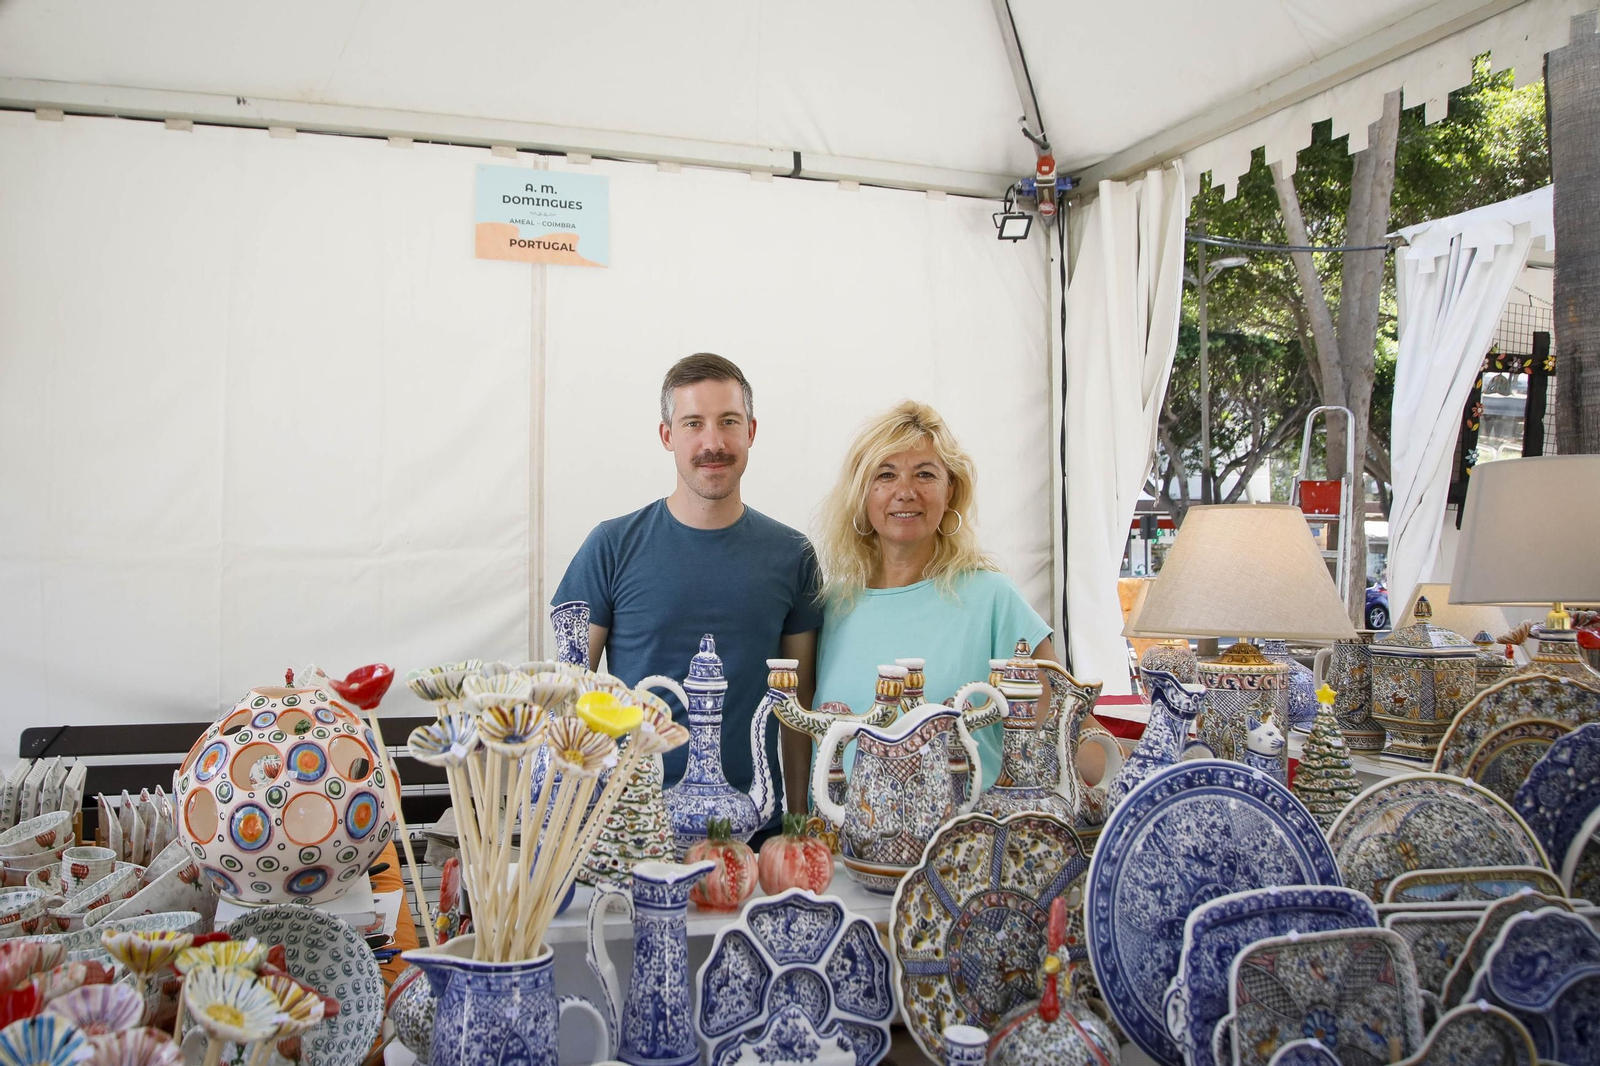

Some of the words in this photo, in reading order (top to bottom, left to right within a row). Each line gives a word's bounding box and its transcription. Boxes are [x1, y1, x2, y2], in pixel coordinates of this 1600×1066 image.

[525, 183, 537, 193] A.
[502, 195, 583, 210] DOMINGUES
[509, 218, 535, 226] AMEAL
[541, 220, 577, 229] COIMBRA
[509, 238, 576, 252] PORTUGAL
